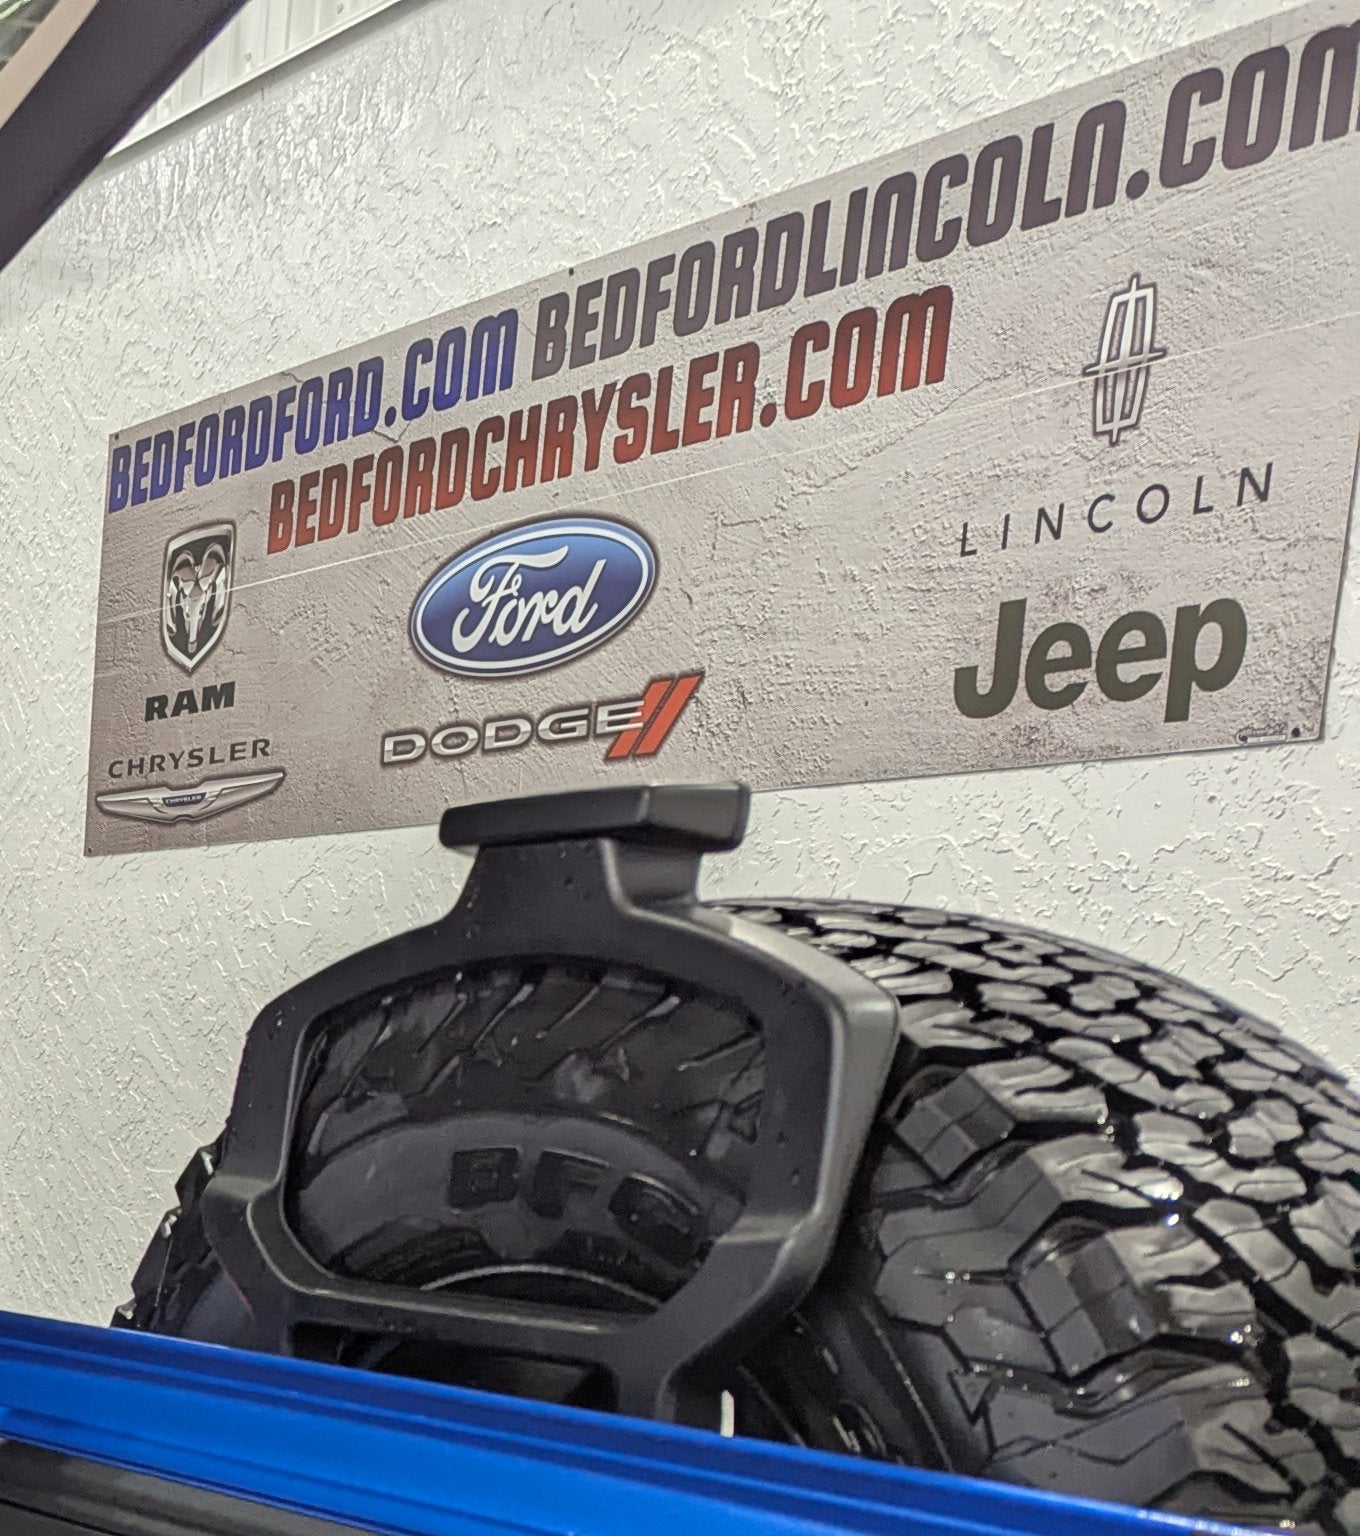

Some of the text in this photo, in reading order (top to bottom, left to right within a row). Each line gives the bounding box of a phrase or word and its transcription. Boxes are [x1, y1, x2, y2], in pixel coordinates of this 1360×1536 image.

[108, 19, 1360, 514] BEDFORDFORD.COM BEDFORDLINCOLN.COM
[266, 284, 955, 555] BEDFORDCHRYSLER.COM
[959, 460, 1274, 558] LINCOLN
[451, 545, 607, 654] Ford
[144, 681, 237, 722] RAM
[953, 597, 1248, 724] Jeep
[108, 738, 271, 779] CHRYSLER
[381, 699, 646, 764] DODGE
